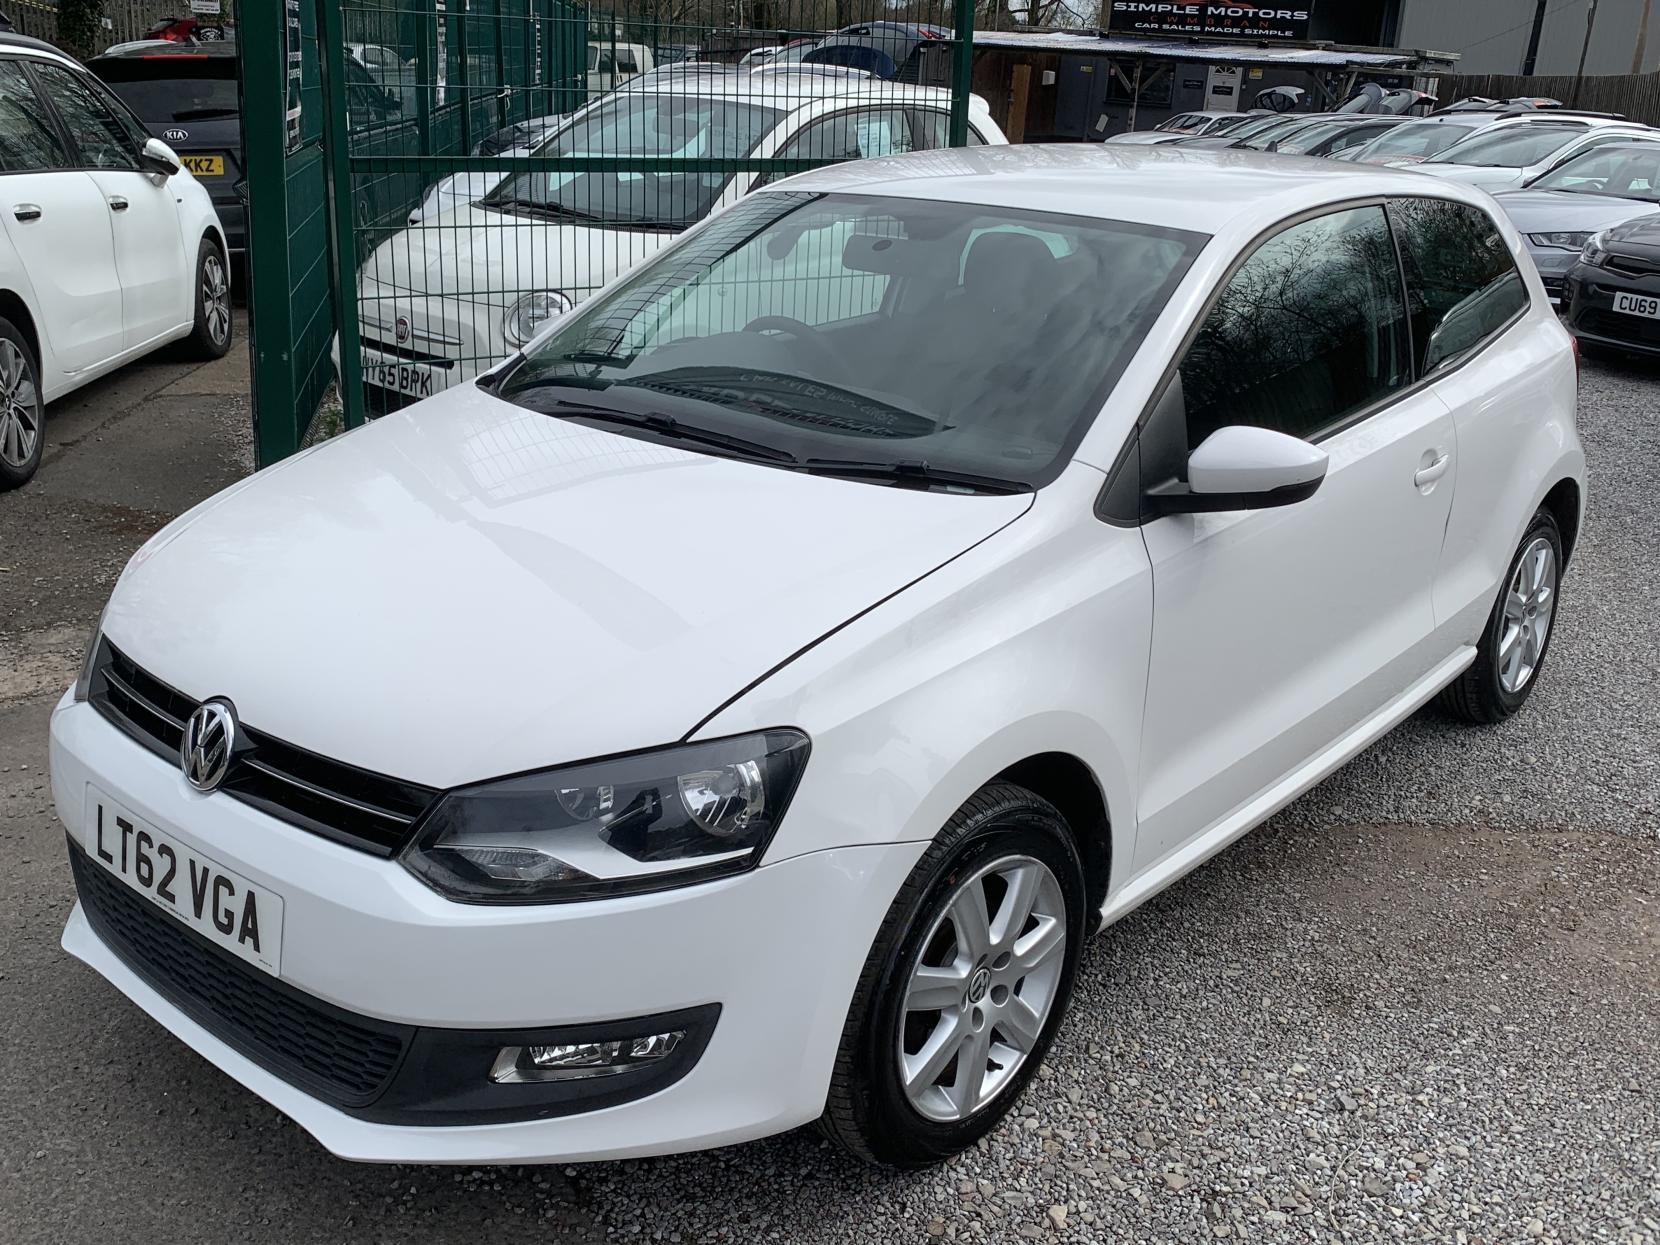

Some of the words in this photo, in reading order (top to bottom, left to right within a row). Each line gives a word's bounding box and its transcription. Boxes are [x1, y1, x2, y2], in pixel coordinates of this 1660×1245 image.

[1113, 2, 1200, 15] SIMPLE
[1207, 6, 1309, 20] MOTORS
[1204, 26, 1241, 34] MADE
[1244, 28, 1294, 37] SIMPLE
[166, 131, 184, 140] KIA
[183, 158, 215, 173] KKZ
[1619, 295, 1658, 315] CU69
[400, 366, 432, 397] BPK
[96, 803, 178, 905] LT62
[188, 857, 261, 954] VGA
